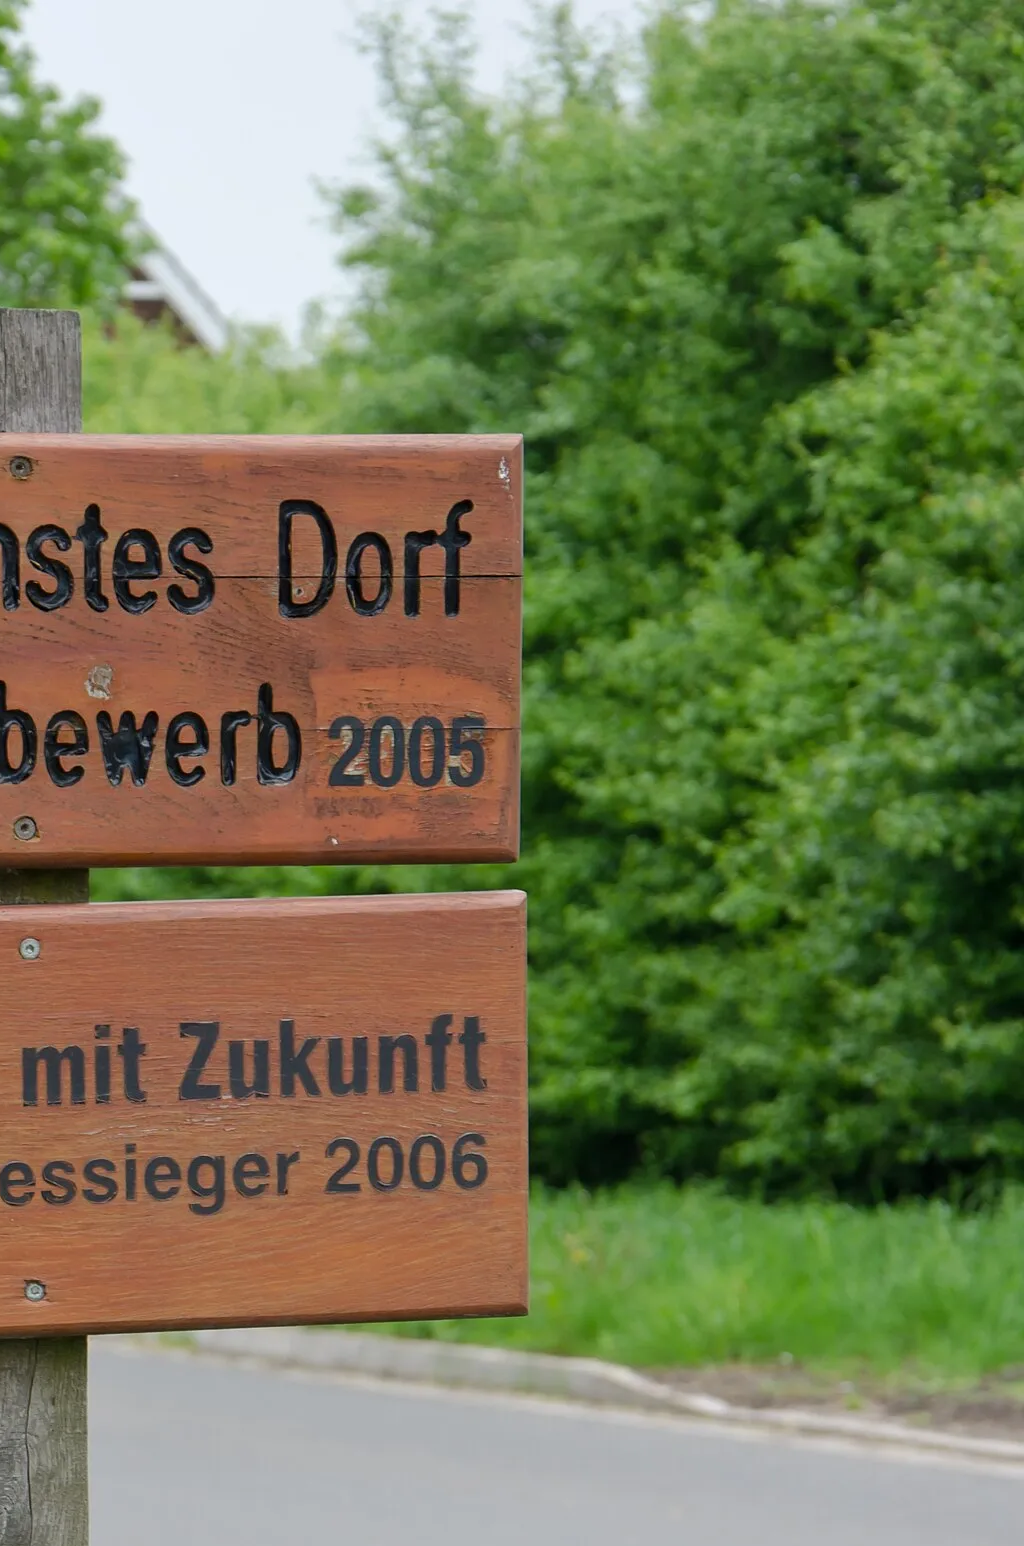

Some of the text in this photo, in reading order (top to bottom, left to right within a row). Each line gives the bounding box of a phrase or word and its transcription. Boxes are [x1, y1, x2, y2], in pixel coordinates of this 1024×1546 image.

[277, 498, 473, 618] Dorf
[327, 714, 486, 788] 2005
[22, 1022, 147, 1107] mit
[178, 1013, 488, 1100] Zukunft
[324, 1132, 489, 1194] 2006
